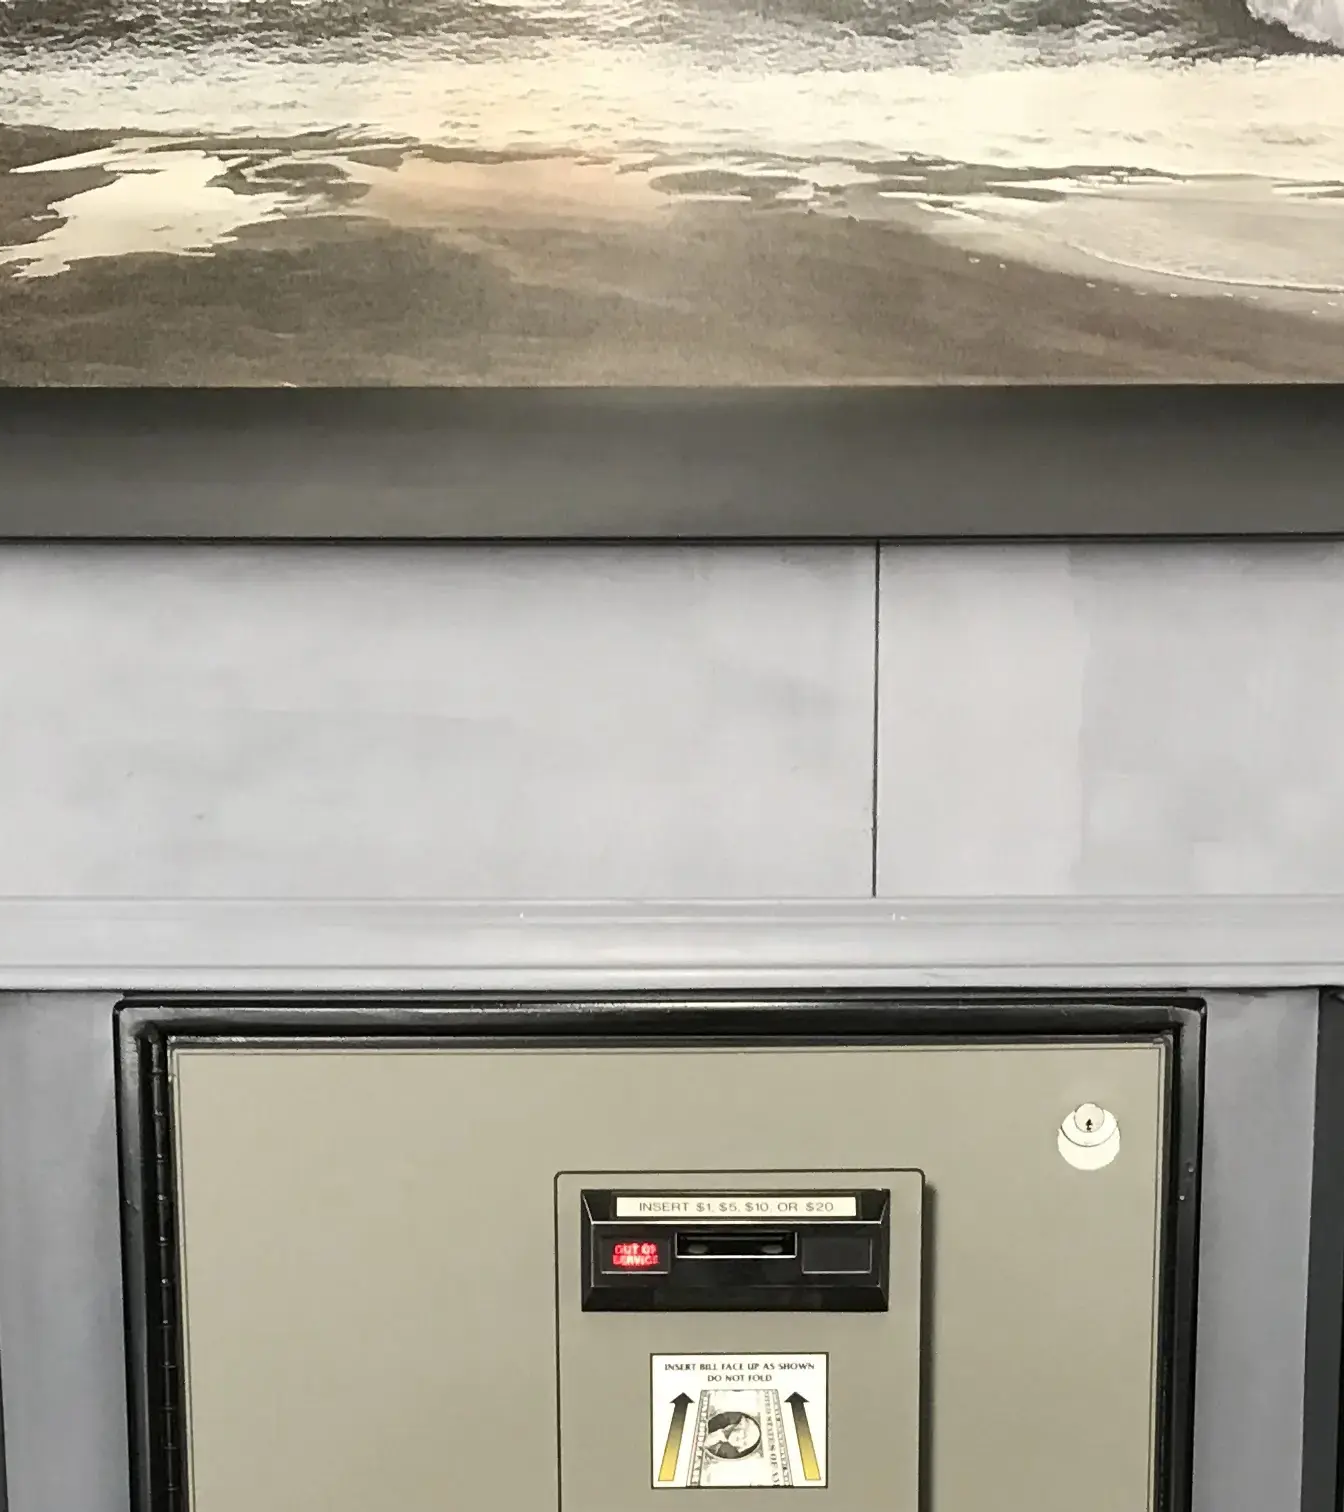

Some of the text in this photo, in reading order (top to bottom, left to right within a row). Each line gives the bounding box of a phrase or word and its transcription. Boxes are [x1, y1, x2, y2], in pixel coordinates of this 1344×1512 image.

[639, 1202, 690, 1213] INSERT
[777, 1202, 799, 1212] OR
[805, 1201, 834, 1212] $20
[665, 1362, 814, 1371] INSERT BILL FACE UP AS SHOWN
[707, 1374, 772, 1382] DO NOT FOLD
